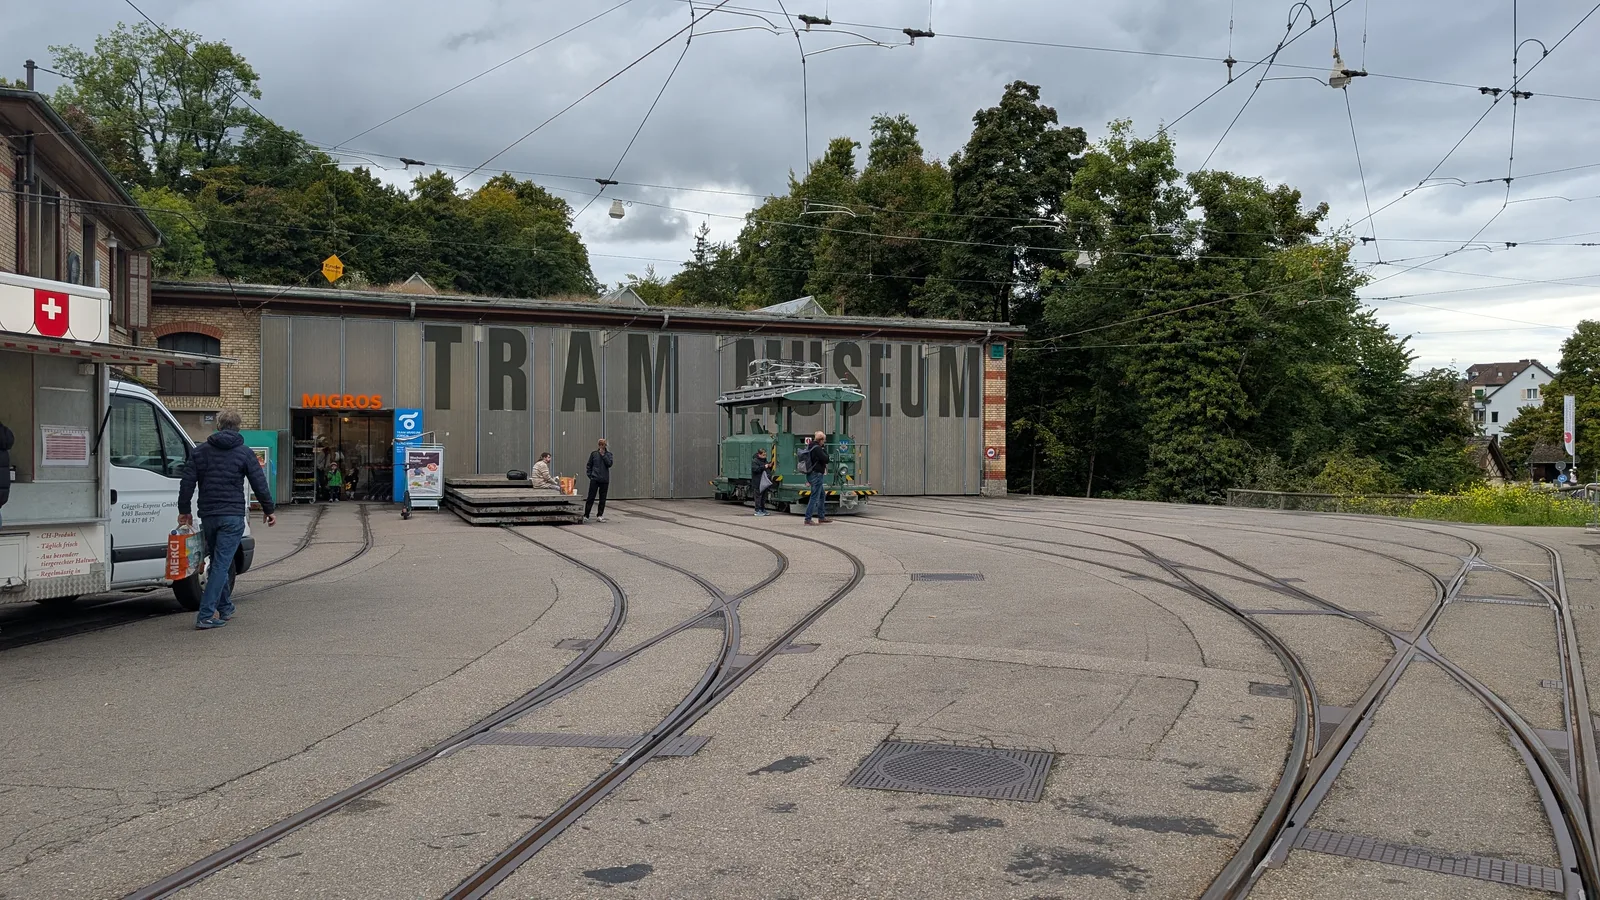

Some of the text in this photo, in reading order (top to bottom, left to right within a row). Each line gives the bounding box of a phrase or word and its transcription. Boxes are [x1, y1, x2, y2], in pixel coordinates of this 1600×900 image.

[424, 325, 980, 418] TRAM MUSEUM
[302, 393, 383, 409] MIGROS
[40, 531, 77, 539] CH-Produkt
[40, 540, 78, 550] Täglich frisch
[40, 559, 76, 567] tiergerechter
[170, 540, 180, 576] MERCI
[40, 568, 74, 577] Regelmässig
